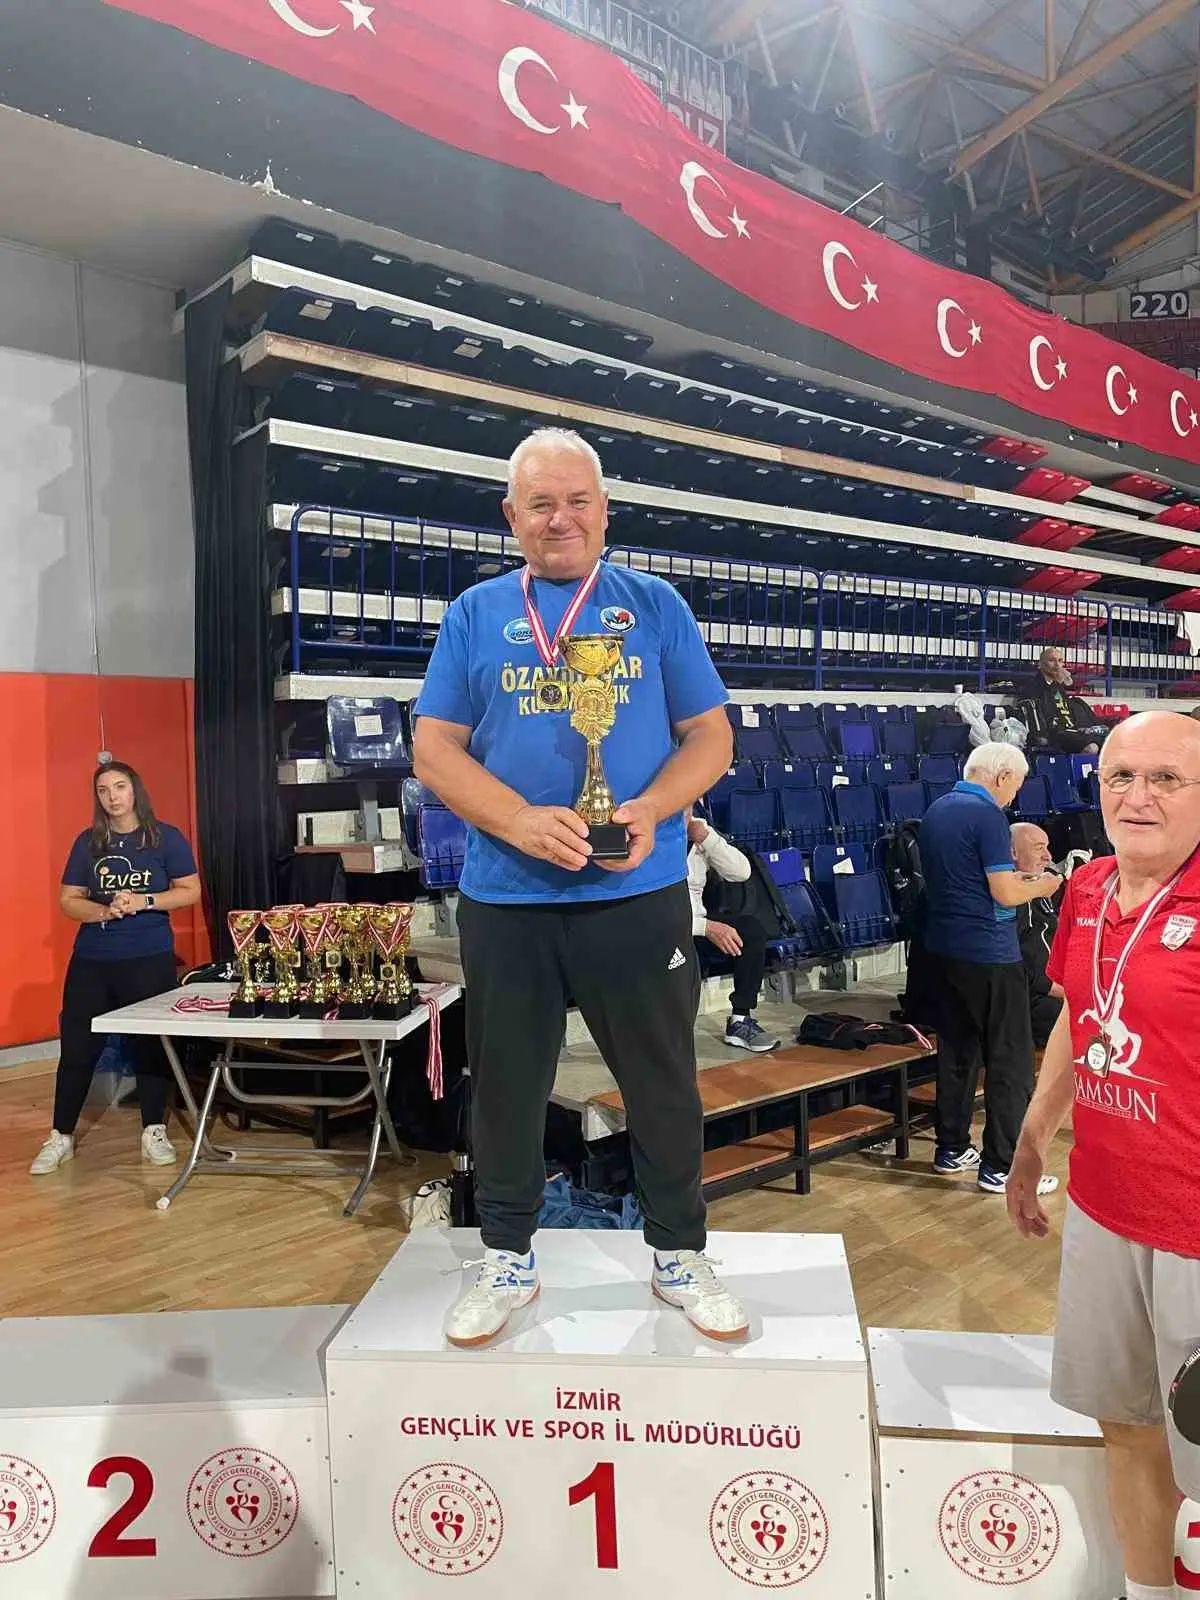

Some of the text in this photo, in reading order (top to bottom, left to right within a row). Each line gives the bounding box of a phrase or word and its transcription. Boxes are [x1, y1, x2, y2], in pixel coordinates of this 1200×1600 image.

[1131, 292, 1188, 317] 220
[1073, 1071, 1157, 1124] SAMSUN
[556, 1387, 621, 1411] İZMİR
[400, 1413, 801, 1449] GENÇLİK VE SPOR İL MÜDÜRLÜĞÜ
[87, 1455, 157, 1558] 2
[568, 1461, 619, 1570] 1
